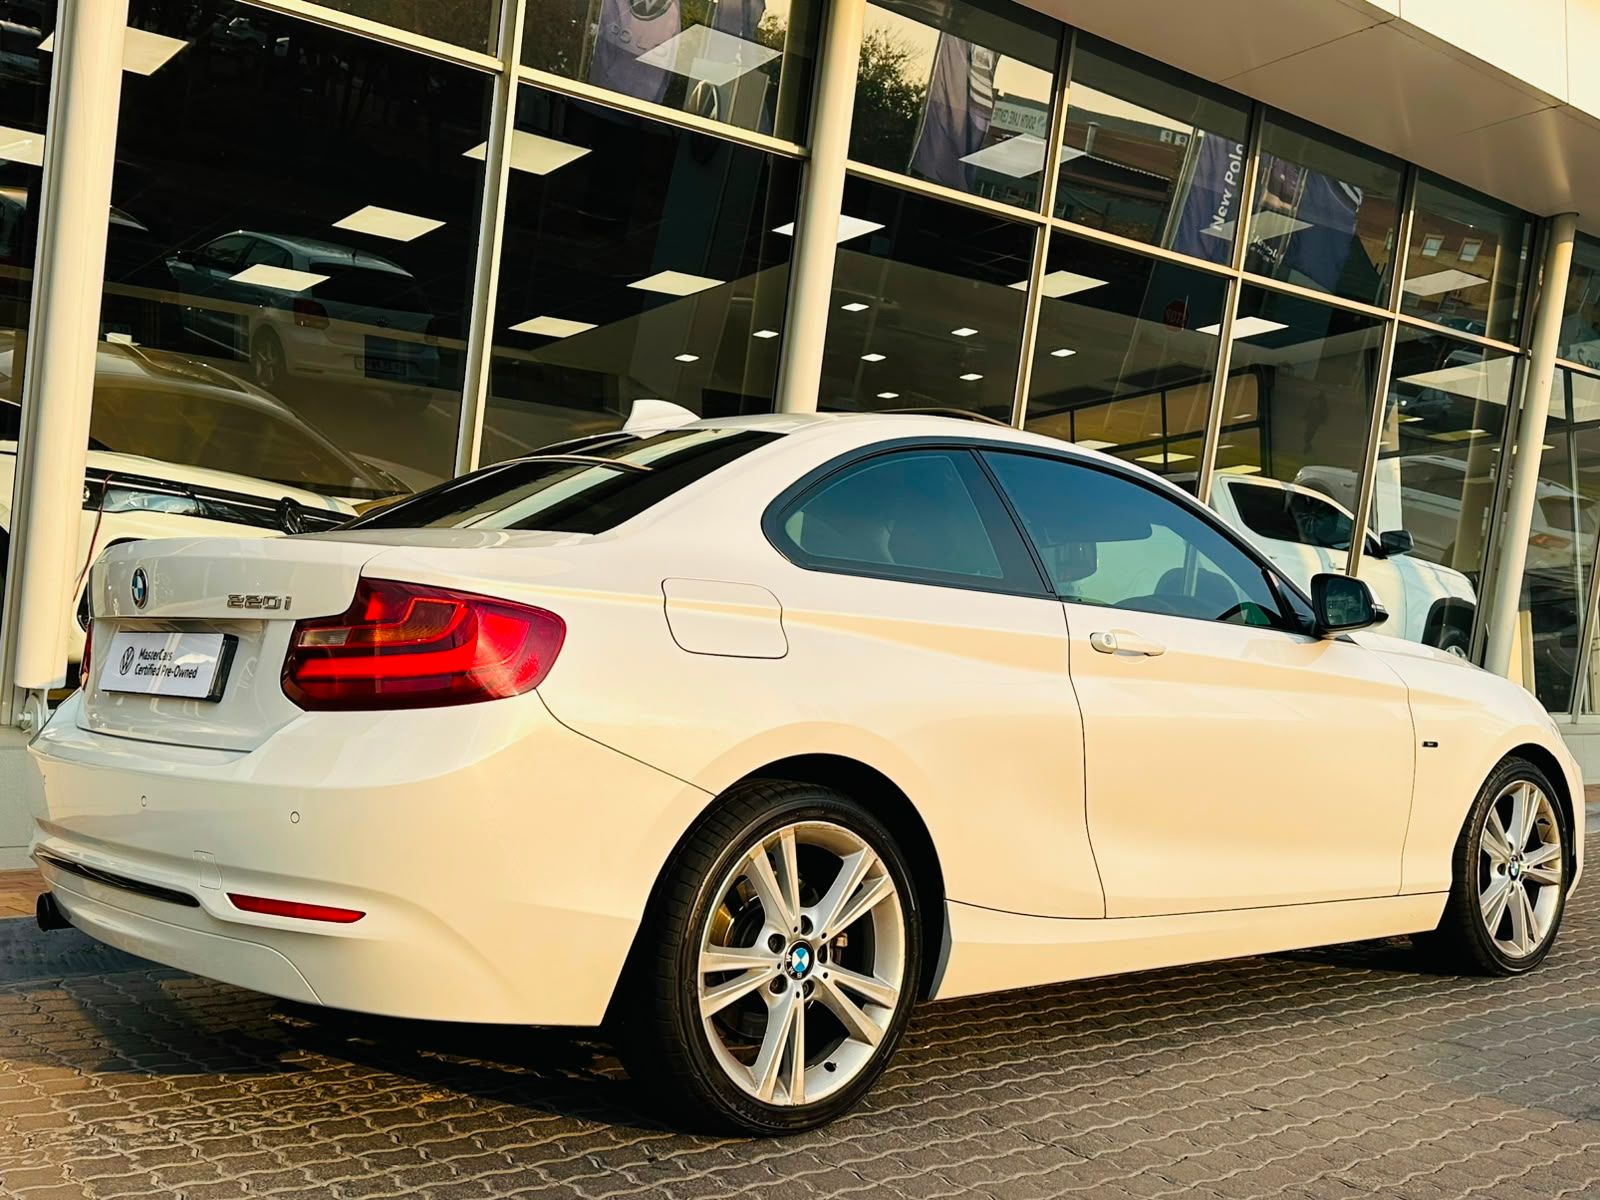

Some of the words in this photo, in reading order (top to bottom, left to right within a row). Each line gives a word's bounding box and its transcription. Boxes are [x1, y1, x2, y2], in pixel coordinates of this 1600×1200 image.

[1210, 188, 1232, 231] New
[227, 594, 292, 611] 220i
[138, 648, 173, 661] MasterCars
[134, 663, 162, 676] Certified
[161, 665, 199, 679] Pre-Owned
